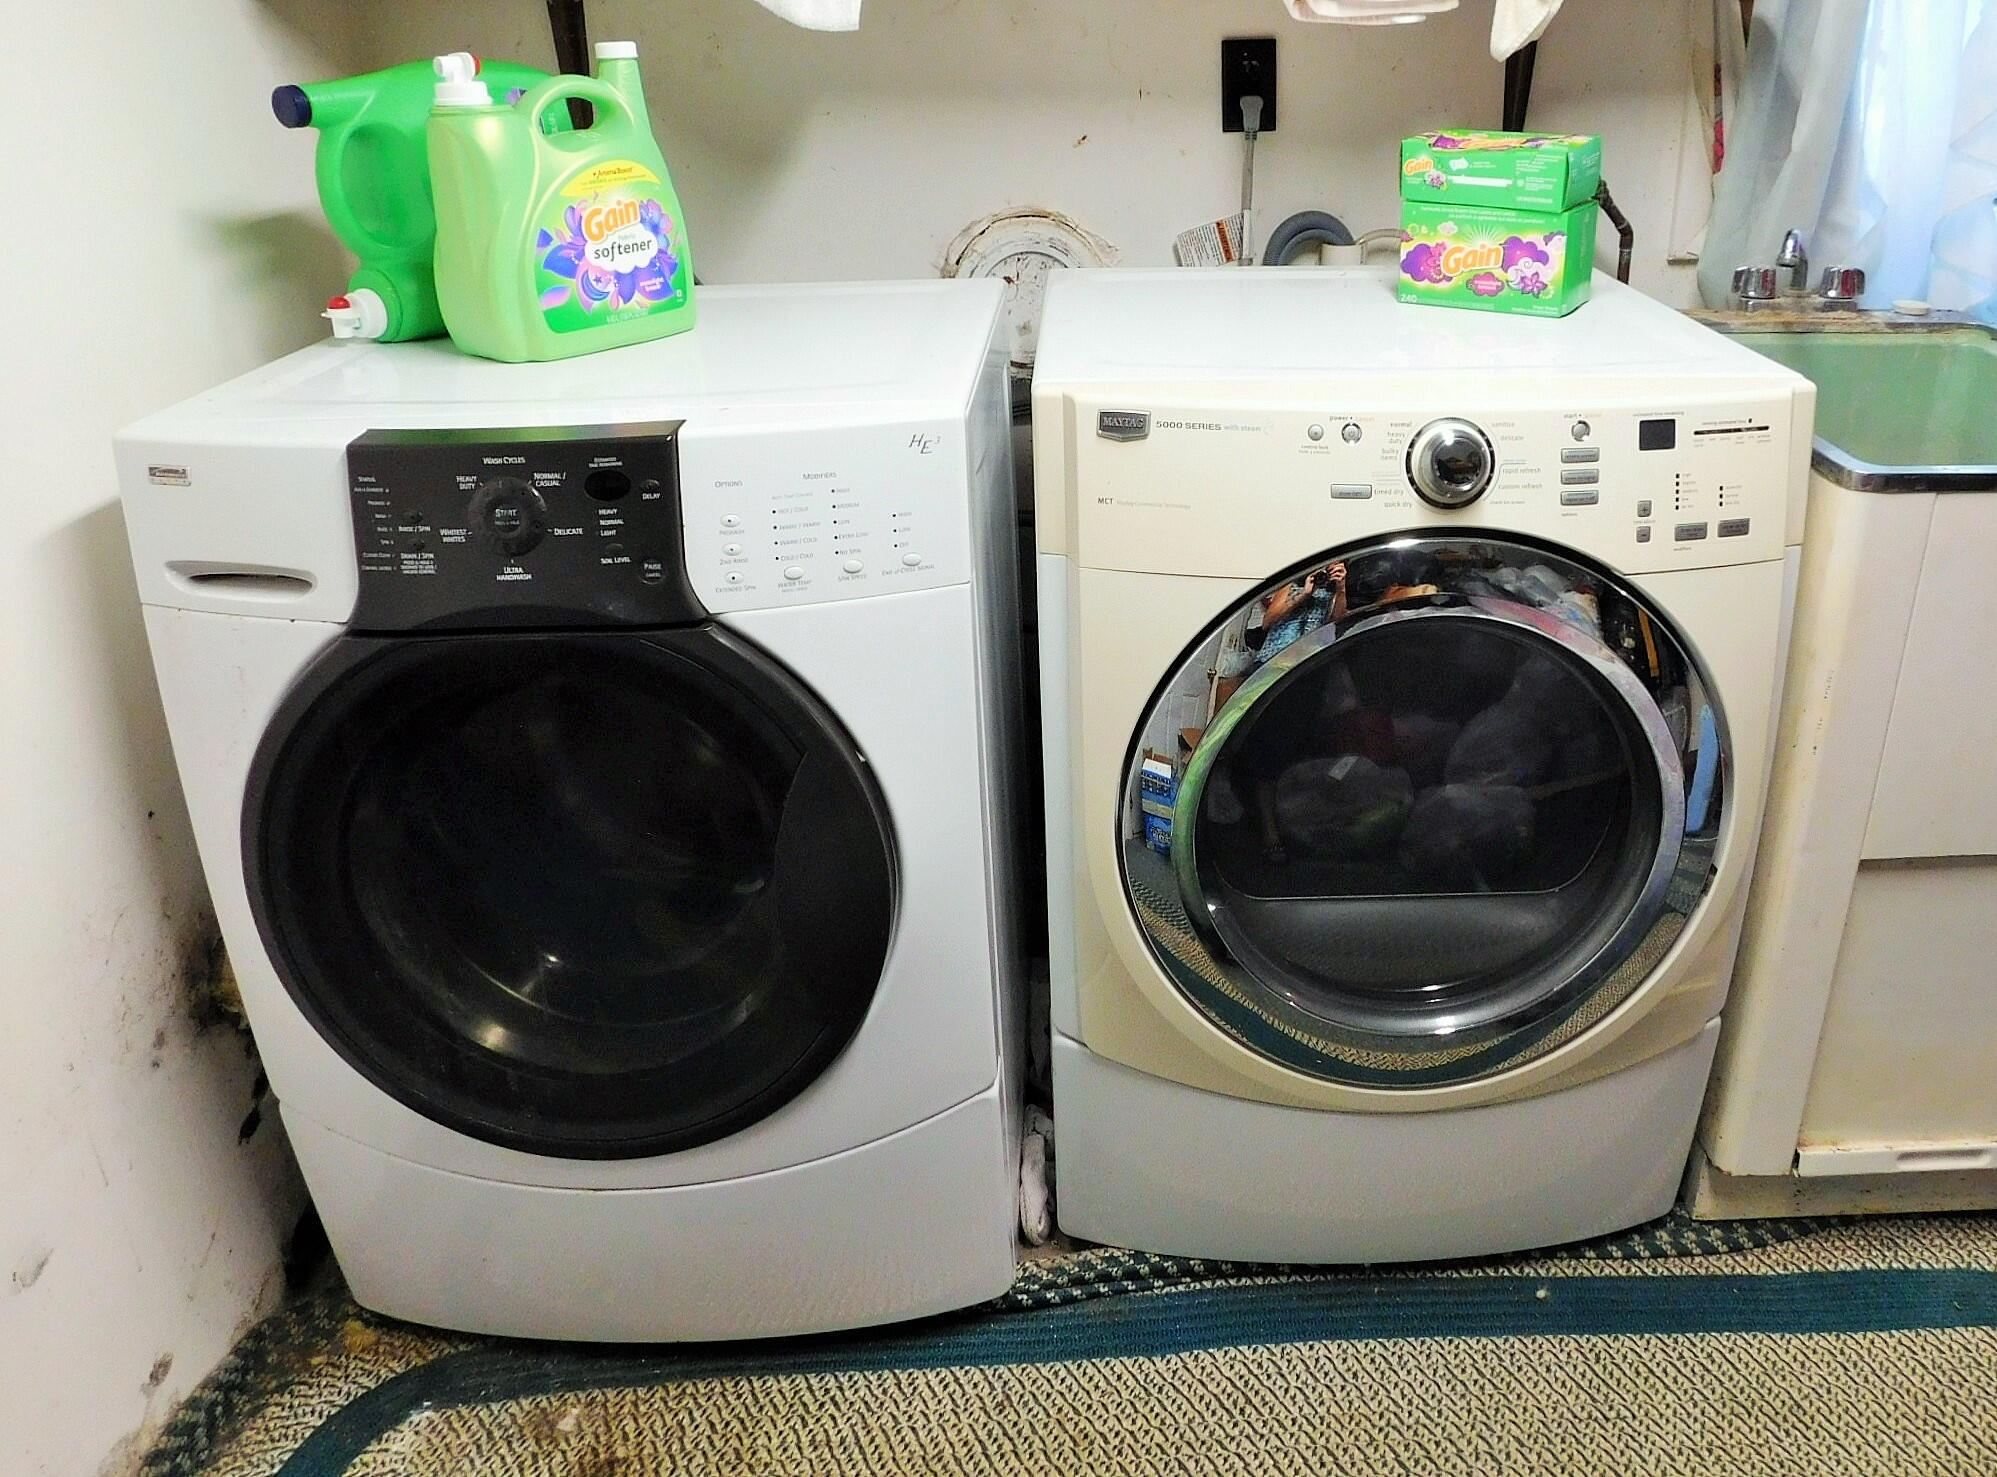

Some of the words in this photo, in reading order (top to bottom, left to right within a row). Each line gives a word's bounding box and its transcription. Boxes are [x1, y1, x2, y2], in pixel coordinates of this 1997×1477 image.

[1405, 157, 1433, 176] Gain
[583, 199, 639, 242] Gain
[593, 239, 652, 262] softener
[1442, 243, 1502, 276] Gain
[1102, 416, 1145, 429] MAYTAG
[1155, 420, 1184, 430] 5000
[1184, 422, 1222, 431] SERIES
[503, 456, 526, 464] CYCLES
[456, 475, 477, 483] HEAVY
[533, 472, 562, 480] NORMAL
[714, 480, 744, 488] OPTIONS
[1097, 497, 1114, 505] MCT
[495, 508, 518, 517] START
[554, 527, 584, 535] DELICATE
